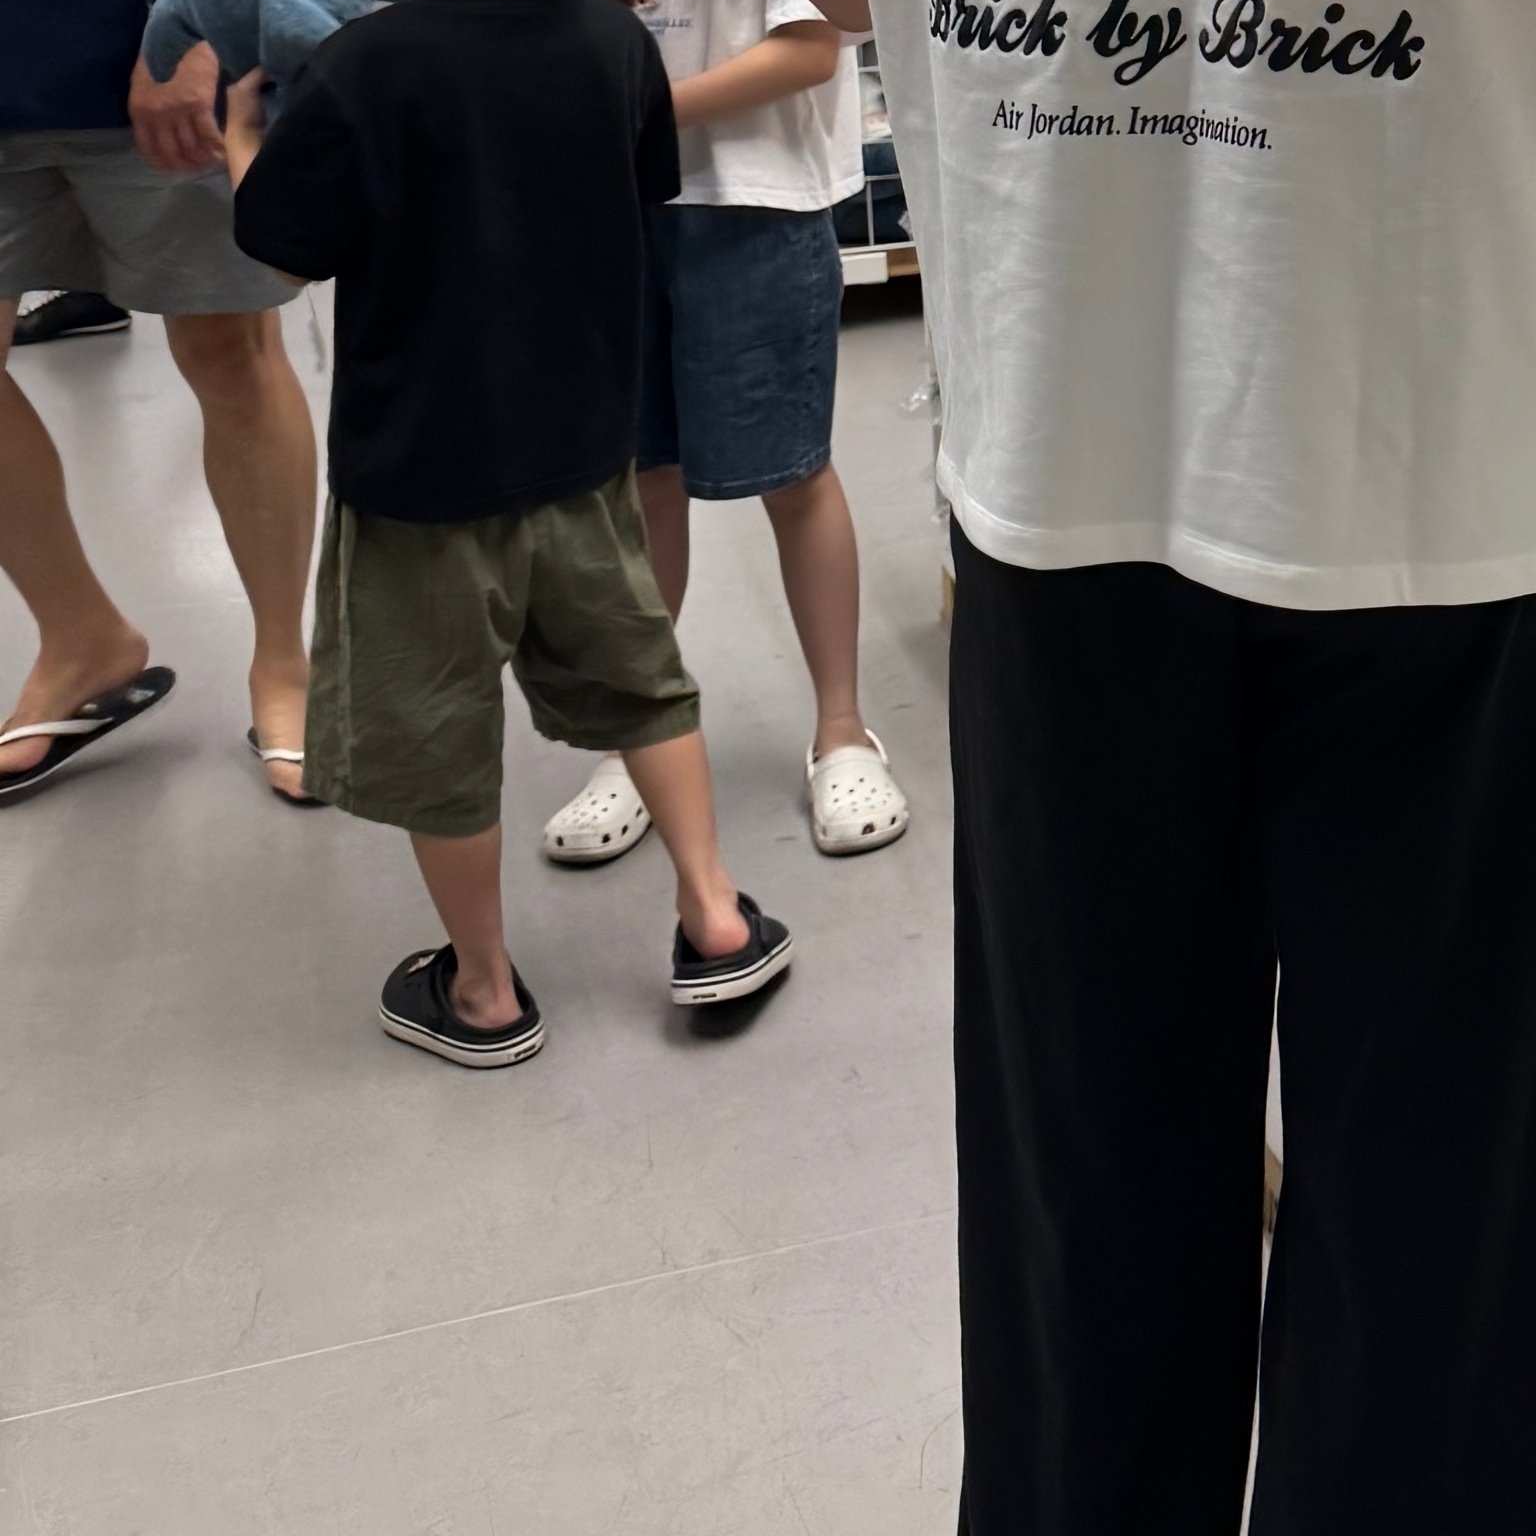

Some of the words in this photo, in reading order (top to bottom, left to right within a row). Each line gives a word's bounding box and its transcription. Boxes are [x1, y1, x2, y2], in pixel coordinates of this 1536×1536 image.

[992, 99, 1024, 131] Air
[1028, 102, 1122, 140] Jordan.
[1127, 105, 1273, 151] Imagination.
